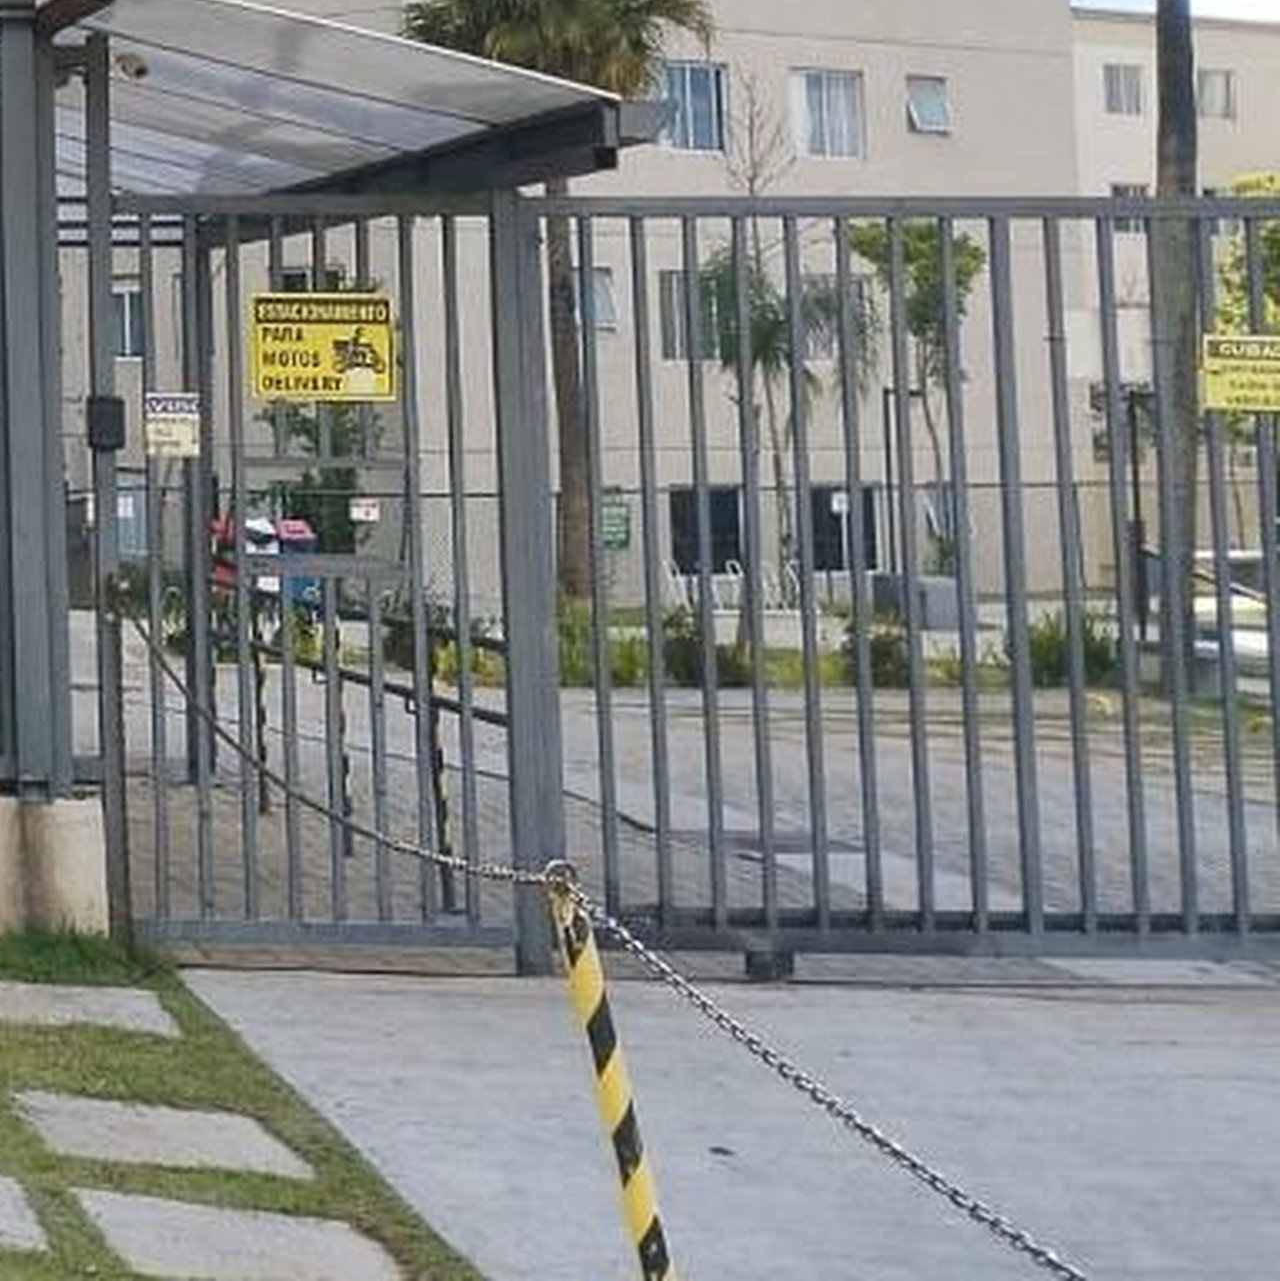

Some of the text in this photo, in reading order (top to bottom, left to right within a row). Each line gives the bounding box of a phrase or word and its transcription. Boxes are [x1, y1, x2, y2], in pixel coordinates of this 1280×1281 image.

[258, 302, 386, 321] ESTACIONAMENTO
[261, 325, 303, 342] PARA
[261, 350, 320, 368] MOTOS
[261, 375, 342, 392] DELIVERY
